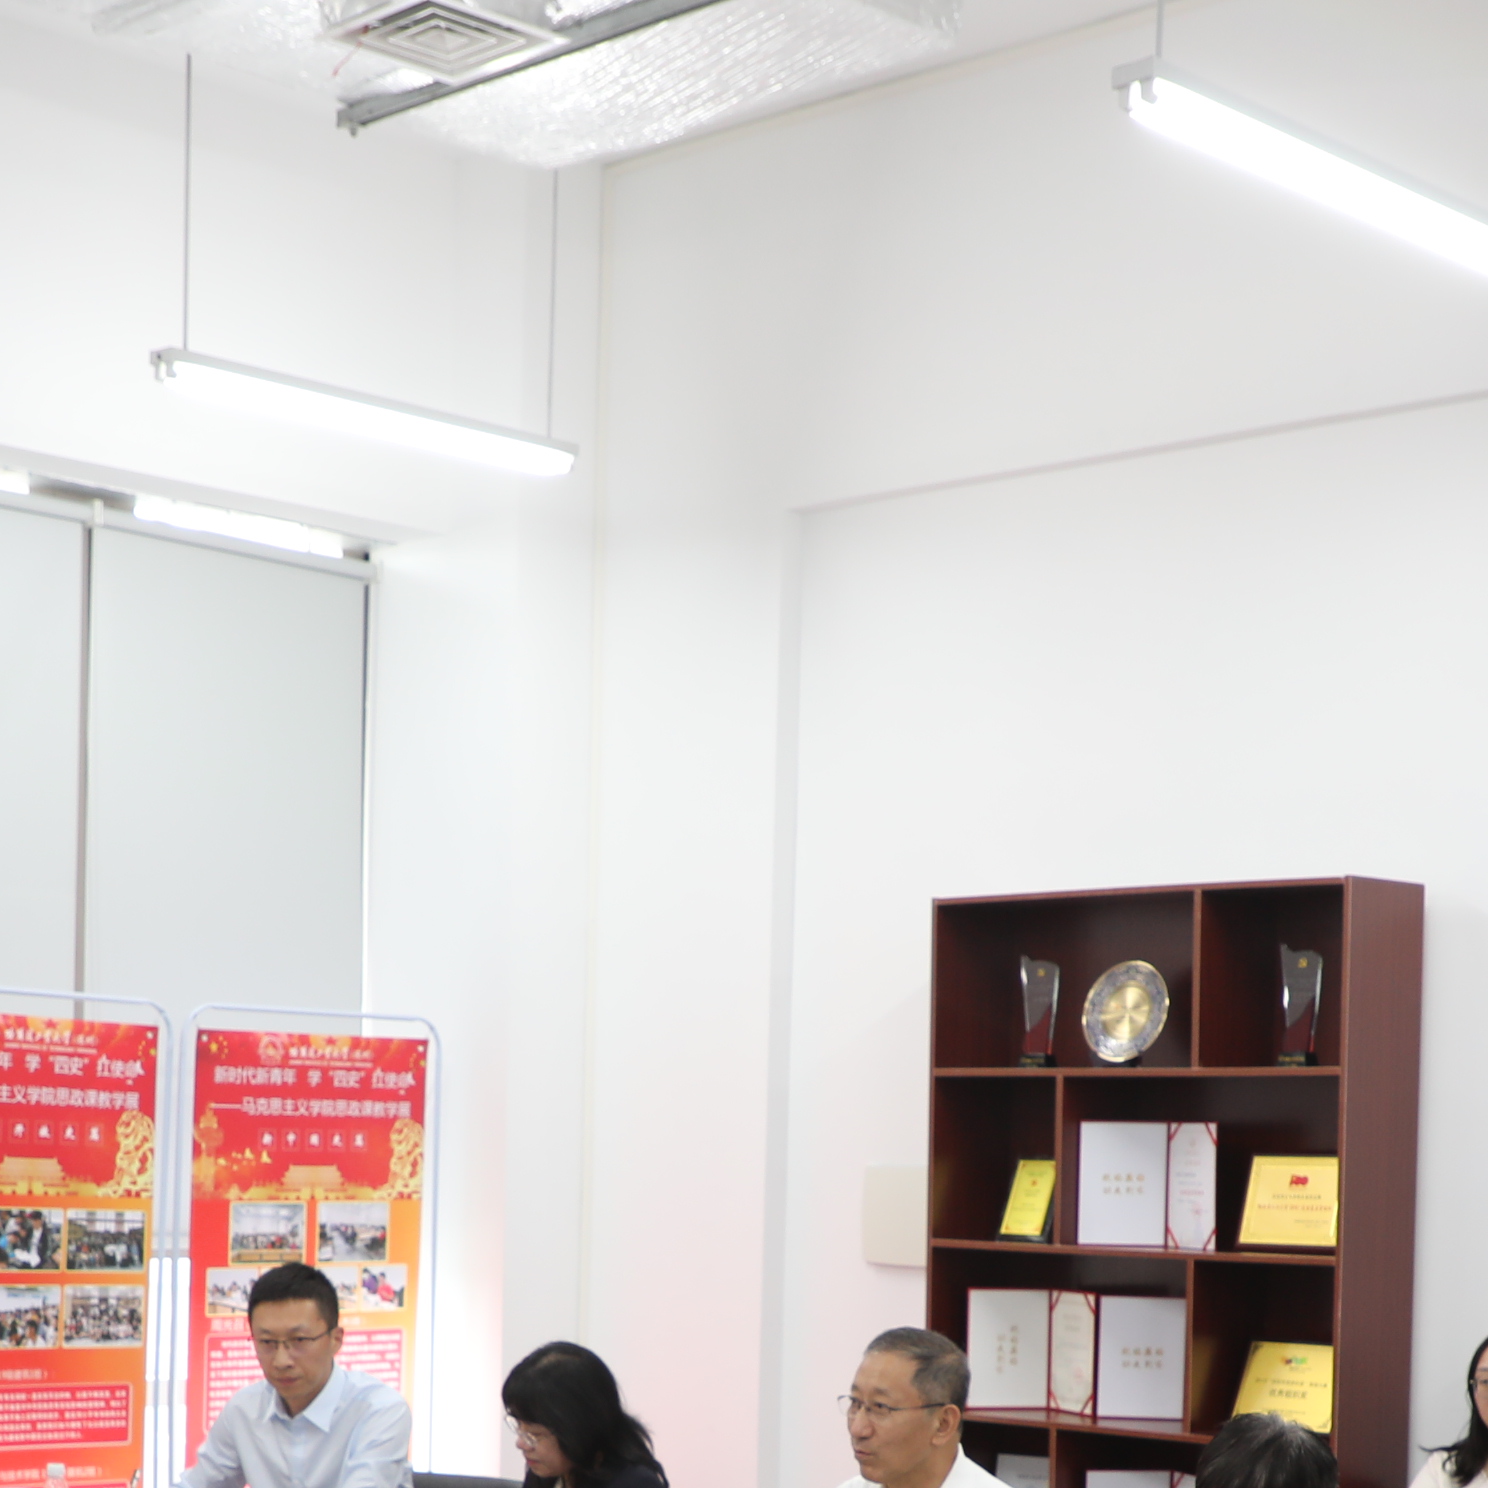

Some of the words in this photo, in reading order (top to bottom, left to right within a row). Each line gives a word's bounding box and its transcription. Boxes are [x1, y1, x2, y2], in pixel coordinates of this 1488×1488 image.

[25, 1053, 41, 1073] 学
[214, 1065, 296, 1086] 新时代新青年
[307, 1068, 323, 1088] 学
